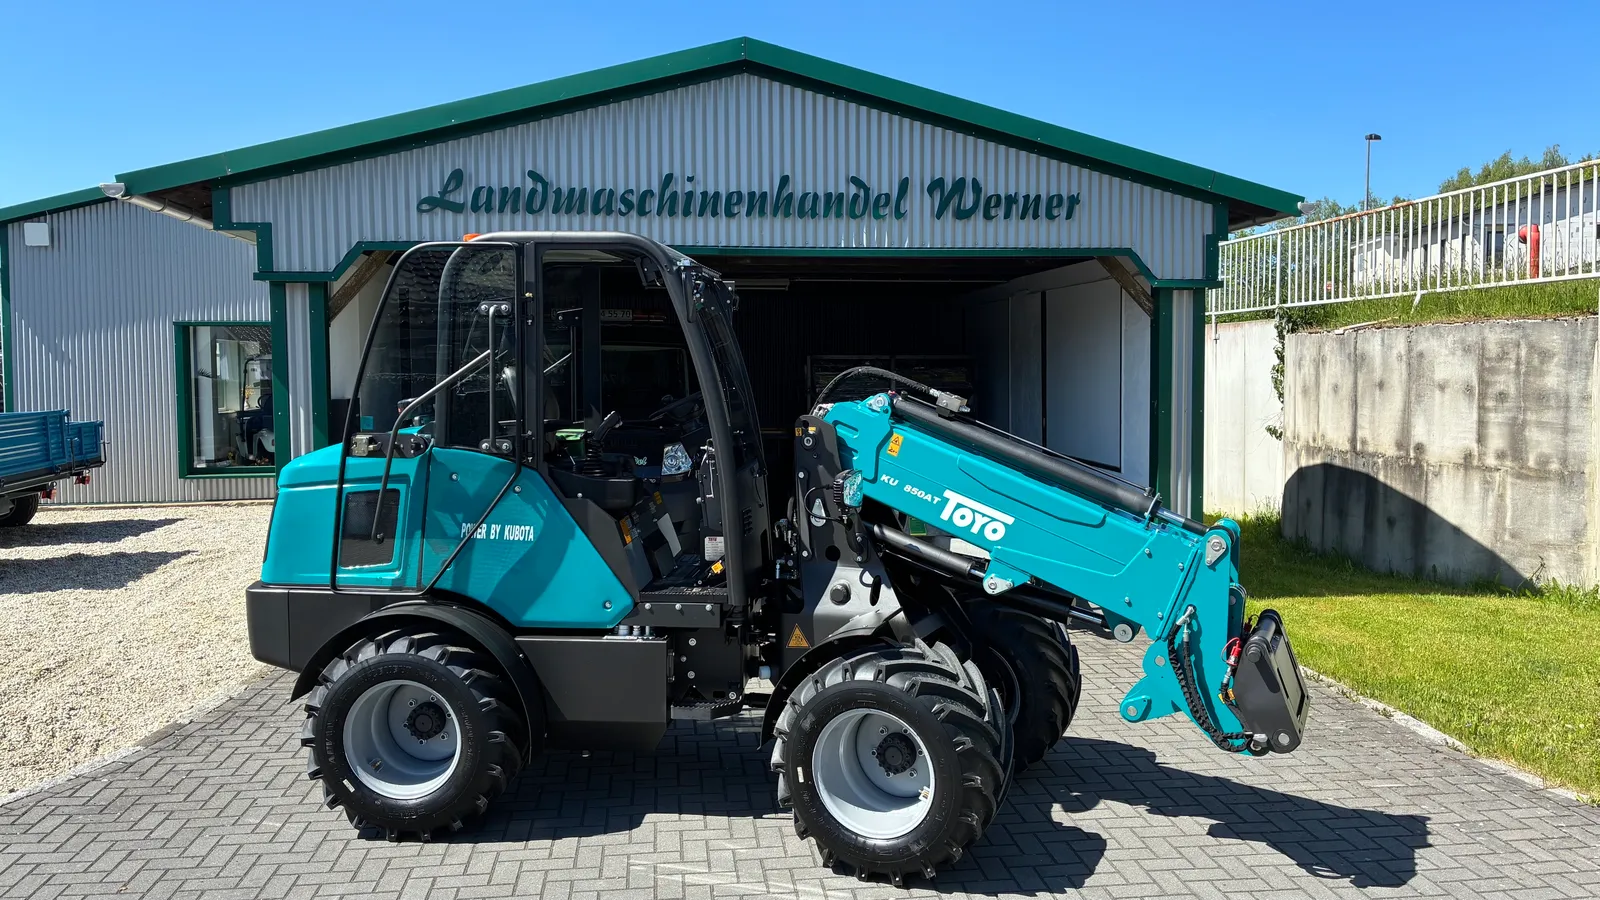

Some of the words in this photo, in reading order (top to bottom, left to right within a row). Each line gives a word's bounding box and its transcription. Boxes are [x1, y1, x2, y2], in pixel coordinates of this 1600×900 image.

[417, 168, 909, 220] Landmaschinenhandel
[927, 176, 1080, 221] Werner
[880, 474, 899, 486] KU
[903, 484, 941, 505] 850AT
[490, 524, 501, 539] BY
[503, 525, 534, 541] KUBOTA
[939, 489, 1015, 541] TOYO
